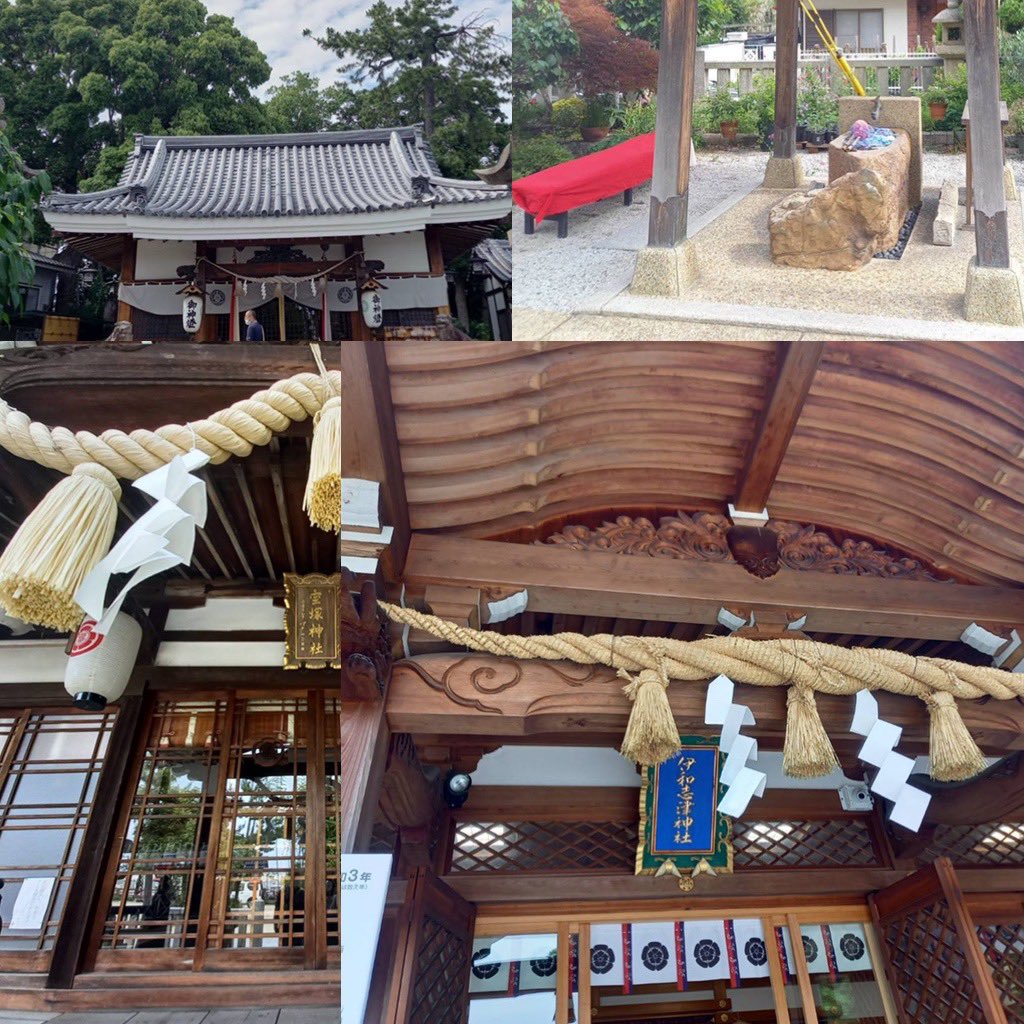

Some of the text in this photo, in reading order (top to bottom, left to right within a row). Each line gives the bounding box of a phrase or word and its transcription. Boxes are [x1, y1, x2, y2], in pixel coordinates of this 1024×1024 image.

[674, 757, 697, 843] 伊和志津神社
